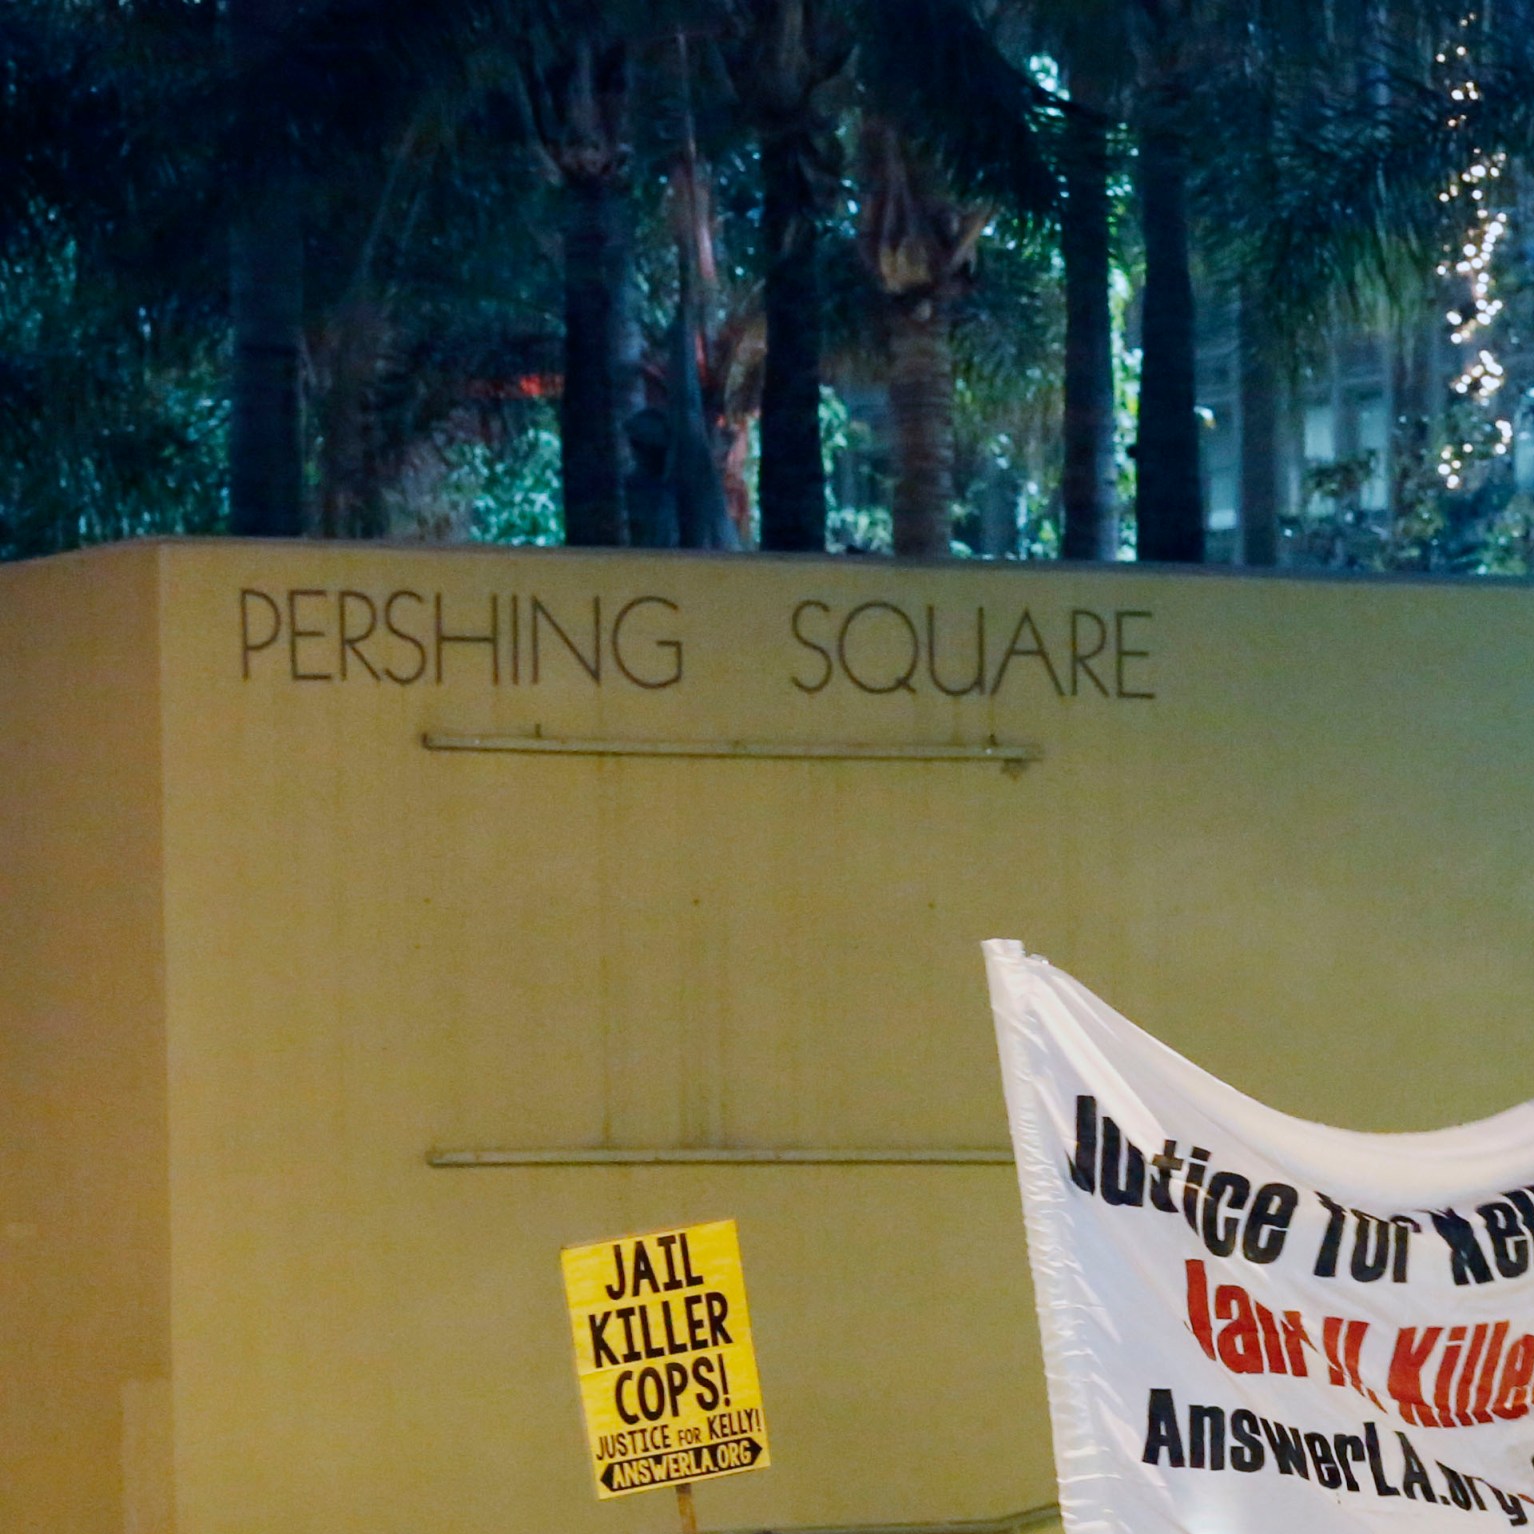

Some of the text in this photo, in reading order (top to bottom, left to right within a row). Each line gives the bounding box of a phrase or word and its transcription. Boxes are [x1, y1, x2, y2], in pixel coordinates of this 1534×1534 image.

[239, 588, 1157, 700] PERSHING SQUARE
[604, 1232, 704, 1301] JAIL
[588, 1291, 734, 1369] KILLER
[615, 1353, 731, 1426] COPS!
[596, 1407, 763, 1461] JUSTICE FOR KELLY!
[612, 1439, 752, 1489] ANSWERLA.ORG
